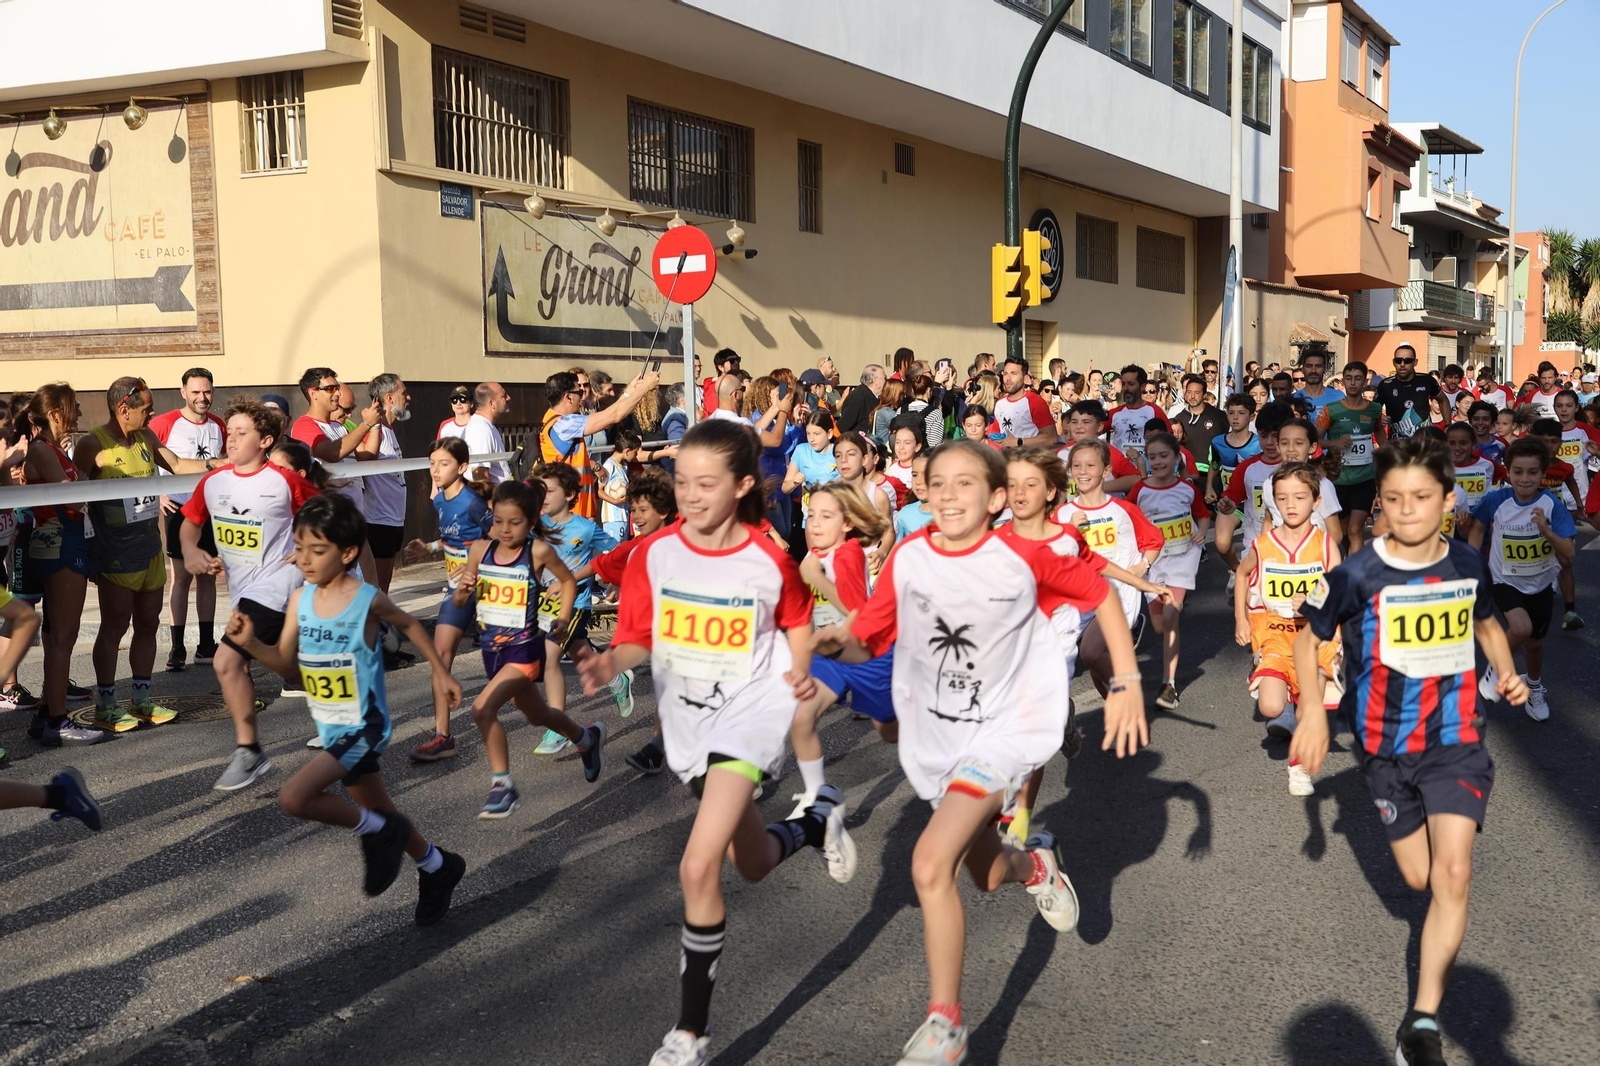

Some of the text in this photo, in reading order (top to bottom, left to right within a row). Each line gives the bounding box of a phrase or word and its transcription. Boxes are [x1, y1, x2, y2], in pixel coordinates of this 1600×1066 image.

[0, 139, 113, 248] and
[441, 195, 468, 206] SALVADOR
[441, 205, 465, 216] ALLENDE
[104, 208, 166, 242] CAFÉ
[523, 231, 542, 252] LE
[139, 246, 185, 259] EL PALO
[537, 242, 641, 320] Grand
[1351, 443, 1366, 454] 49
[1557, 444, 1580, 457] 089
[1460, 480, 1484, 493] 126
[216, 526, 259, 548] 1035
[619, 526, 625, 537] 9
[1087, 527, 1116, 547] 16
[15, 548, 23, 568] PALO
[1505, 540, 1552, 560] 1016
[478, 581, 527, 606] 1091
[662, 609, 748, 647] 1108
[1393, 608, 1469, 643] 1019
[306, 675, 353, 699] 031
[948, 680, 966, 689] 45
